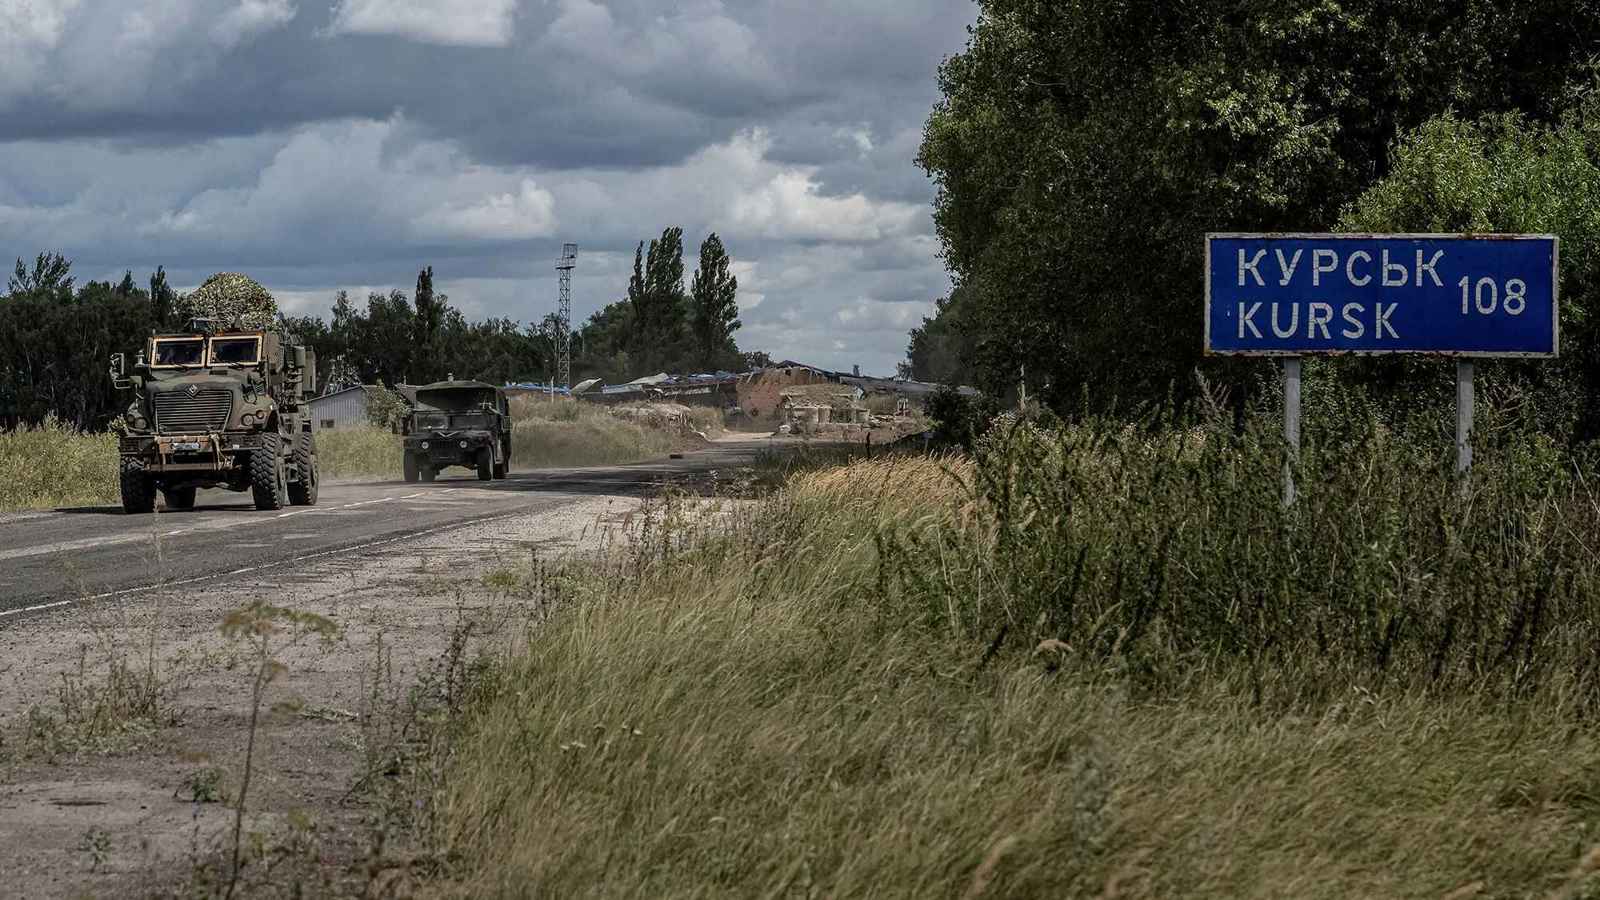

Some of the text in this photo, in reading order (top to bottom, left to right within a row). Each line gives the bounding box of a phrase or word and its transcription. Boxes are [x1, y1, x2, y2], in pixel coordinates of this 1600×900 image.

[1238, 248, 1444, 287] КУРСЬК
[1458, 275, 1527, 315] 108
[1238, 302, 1400, 339] KURSK
